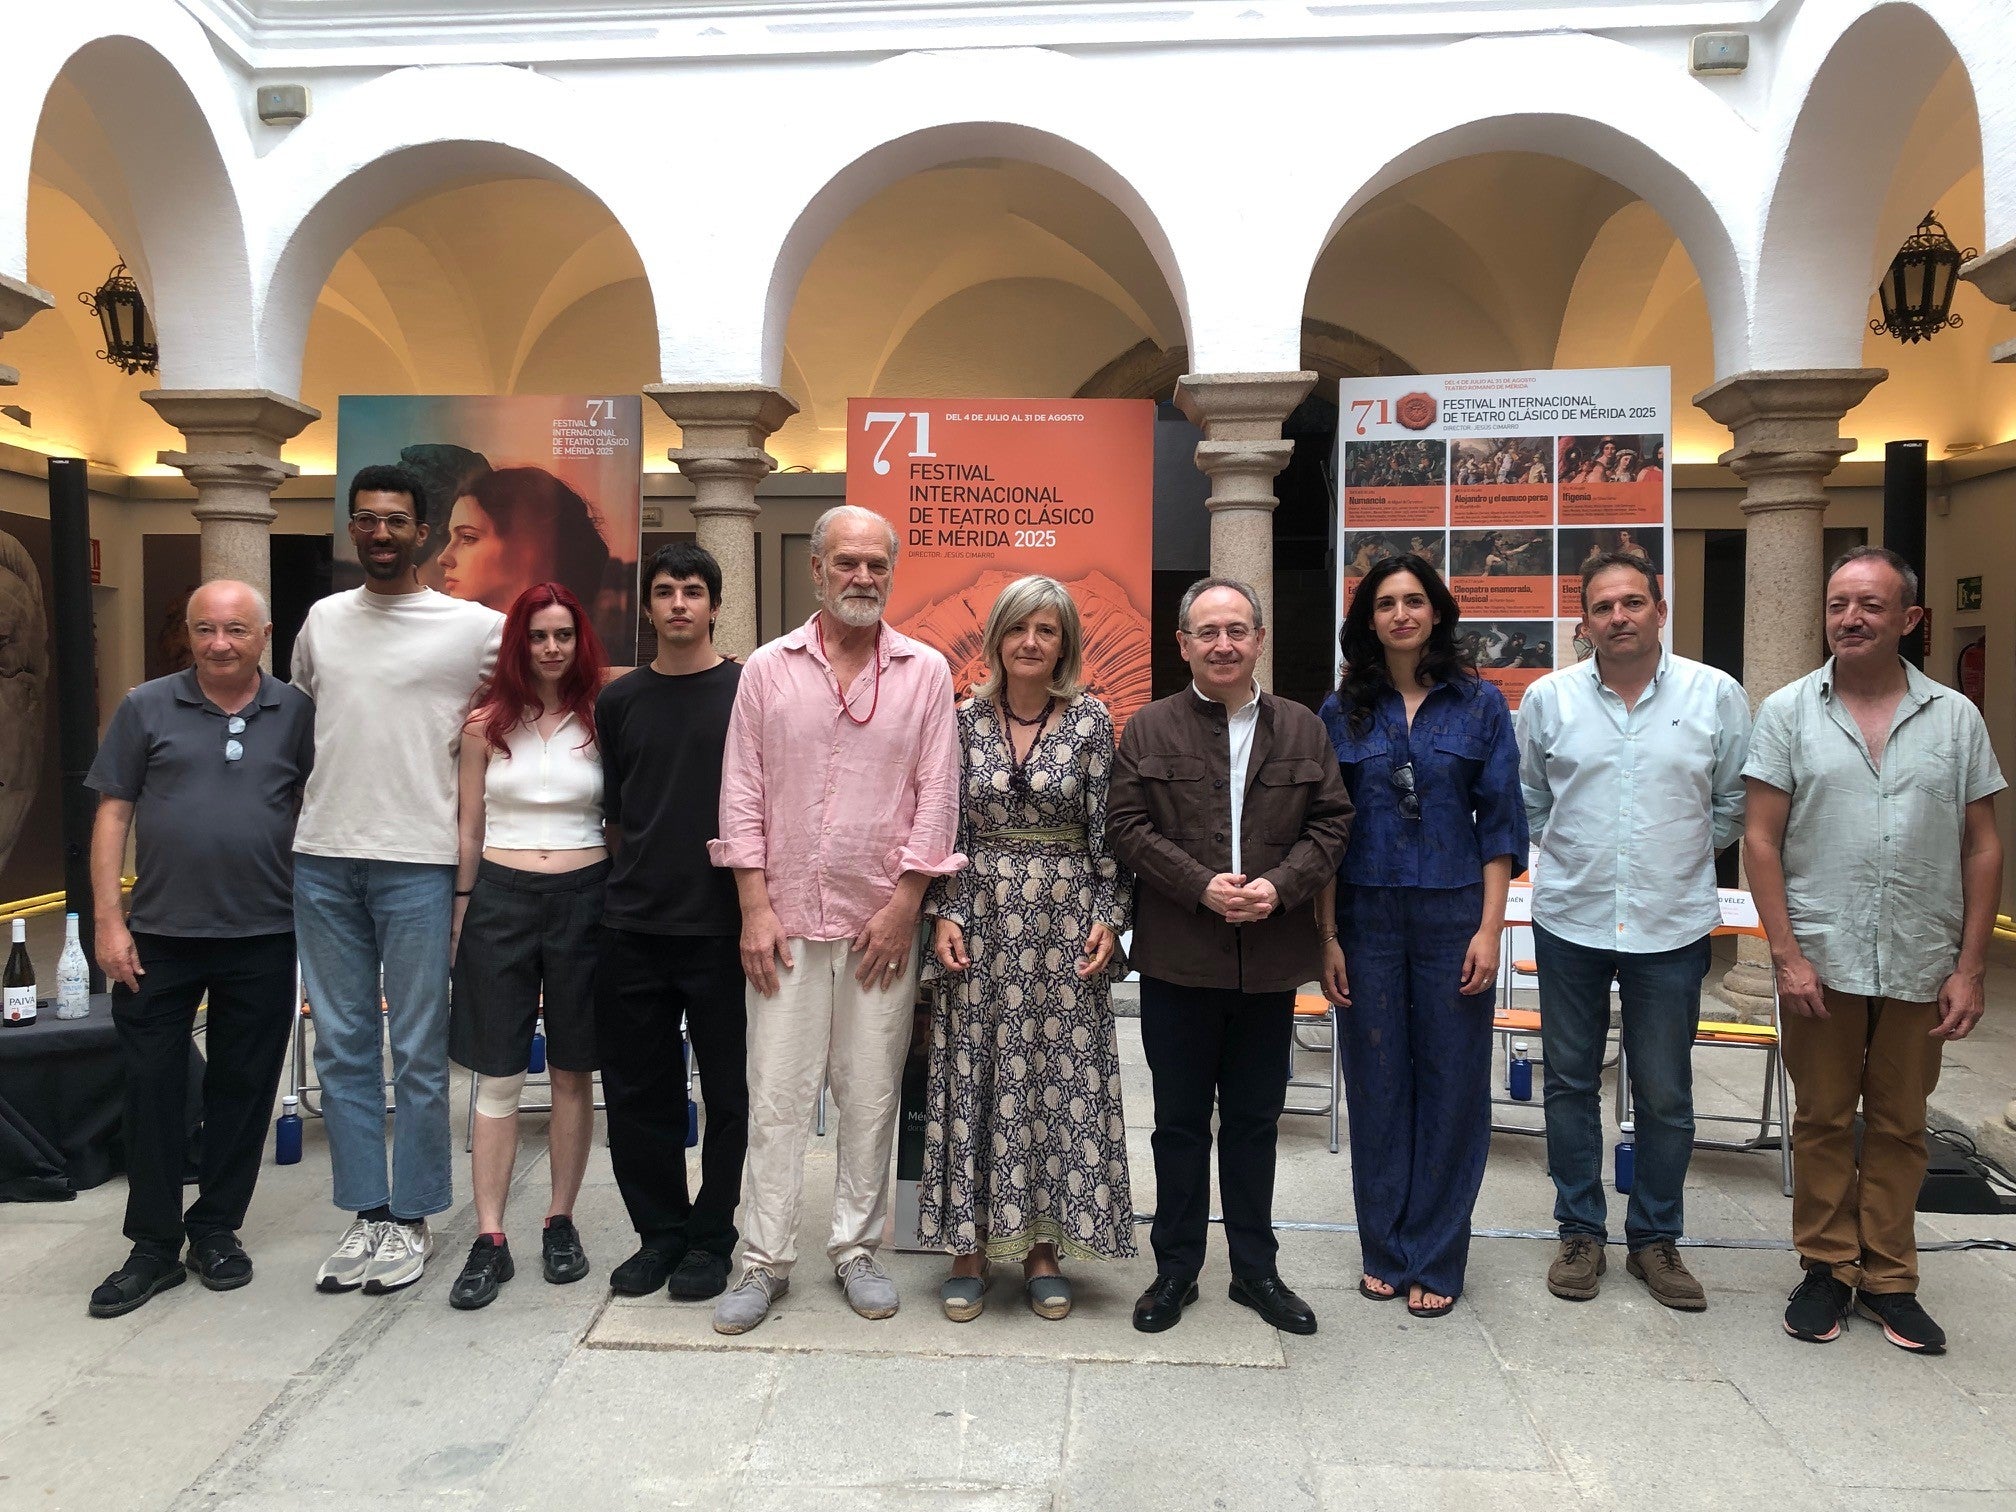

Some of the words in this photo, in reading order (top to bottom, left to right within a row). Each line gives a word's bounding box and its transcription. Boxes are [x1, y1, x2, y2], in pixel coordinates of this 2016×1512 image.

[1443, 398, 1496, 410] FESTIVAL
[1498, 396, 1596, 408] INTERNACIONAL
[586, 400, 616, 427] 71
[985, 414, 1010, 422] JULIO
[1351, 399, 1392, 435] 71
[1443, 412, 1458, 422] DE
[1461, 411, 1506, 422] TEATRO
[1508, 408, 1558, 422] CLÁSICO
[1562, 408, 1578, 420] DE
[1580, 406, 1626, 419] MÉRIDA
[1629, 406, 1656, 418] 2025
[552, 420, 588, 428] FESTIVAL
[552, 428, 616, 436] INTERNACIONAL
[565, 438, 594, 446] TEATRO
[596, 436, 630, 446] CLÁSICO
[864, 412, 936, 475] 71
[552, 447, 563, 455] DE
[910, 464, 995, 481] FESTIVAL
[910, 486, 1064, 503] INTERNACIONAL
[1454, 494, 1487, 504] Alejandro
[1562, 492, 1592, 502] Ifigenia
[1350, 496, 1386, 504] Numancia
[909, 507, 933, 524] DE
[938, 508, 1010, 525] TEATRO
[1014, 504, 1094, 525] CLÁSICO
[909, 530, 933, 546] DE
[938, 525, 1010, 547] MÉRIDA
[1014, 530, 1056, 548] 2025
[1454, 586, 1488, 594] Cleopatra
[1562, 585, 1581, 594] Elect
[10, 996, 34, 1006] PAIVA
